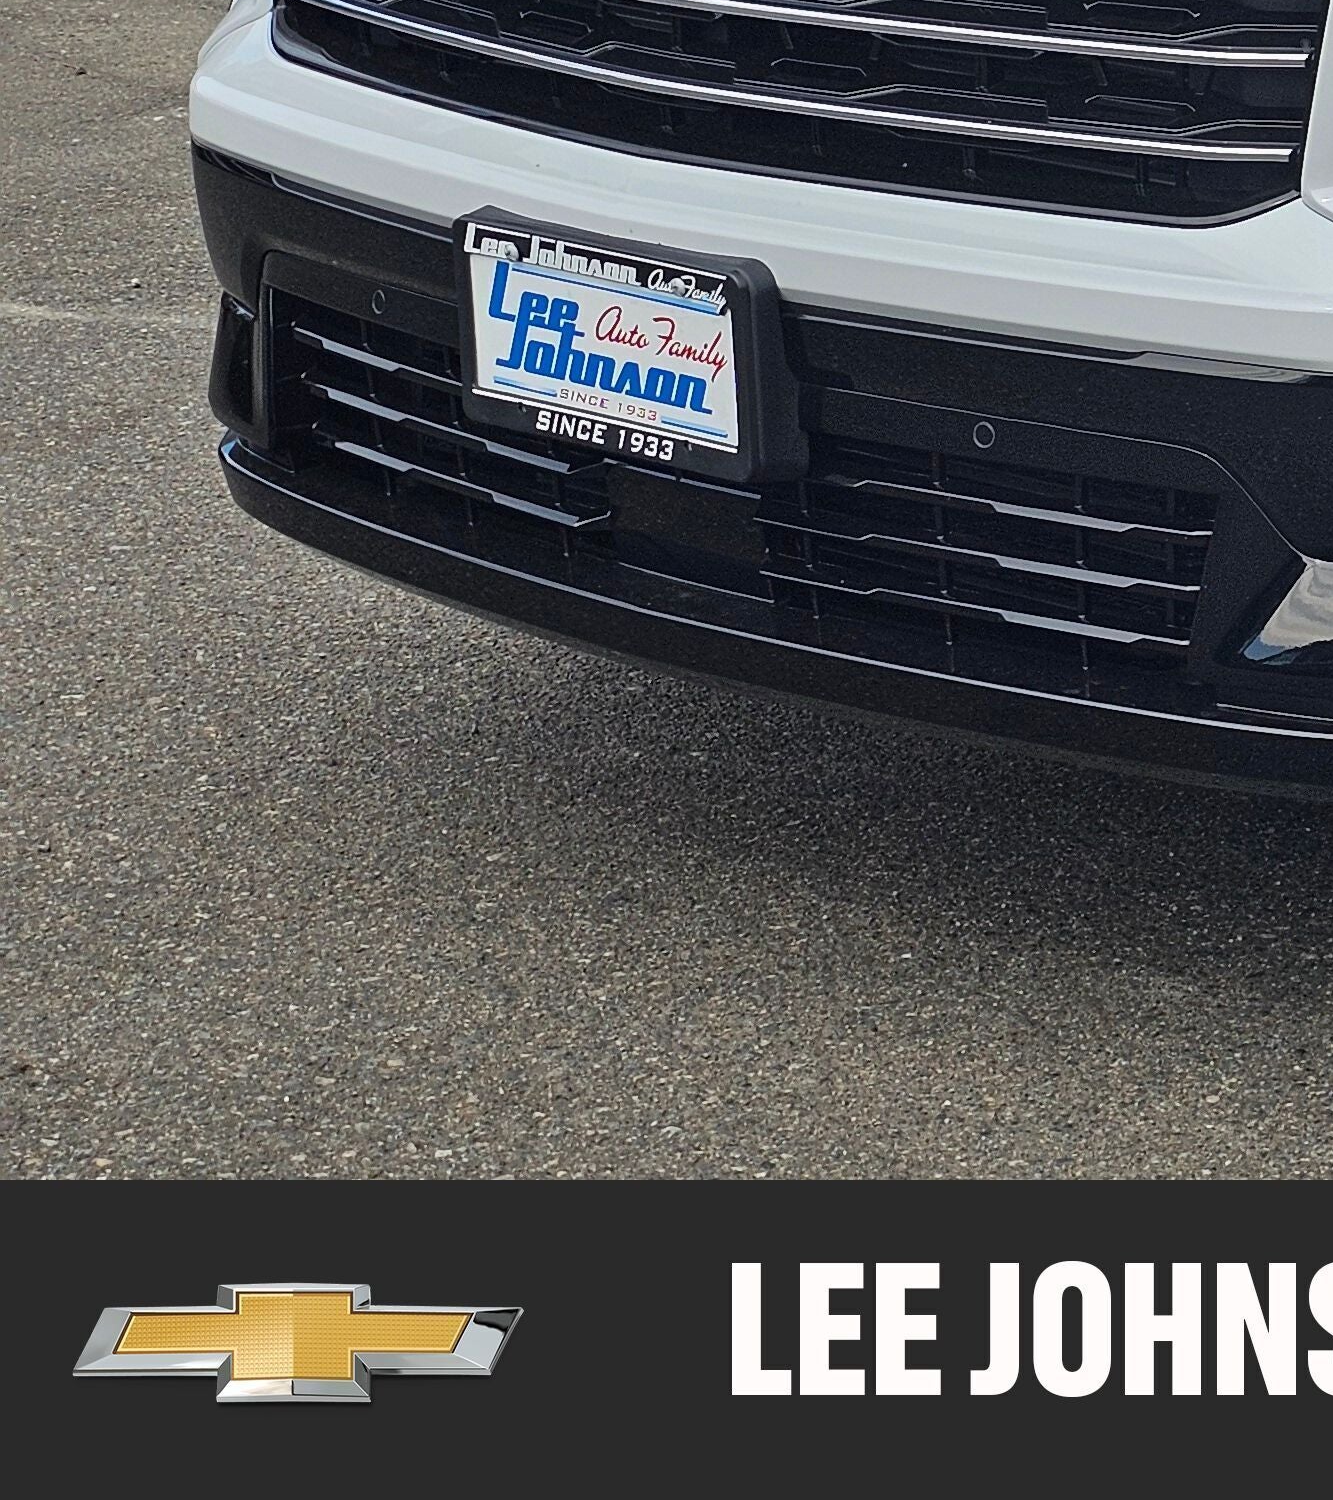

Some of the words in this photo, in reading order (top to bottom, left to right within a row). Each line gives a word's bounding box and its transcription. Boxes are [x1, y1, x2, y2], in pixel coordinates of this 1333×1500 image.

[522, 235, 642, 287] Johnson
[488, 260, 585, 338] Lee
[595, 306, 650, 348] Auto
[652, 317, 728, 382] Family
[496, 315, 713, 415] Johnson
[560, 388, 609, 409] SINCE
[616, 401, 658, 422] 1933
[536, 410, 607, 445] SINCE
[618, 429, 675, 462] 1933
